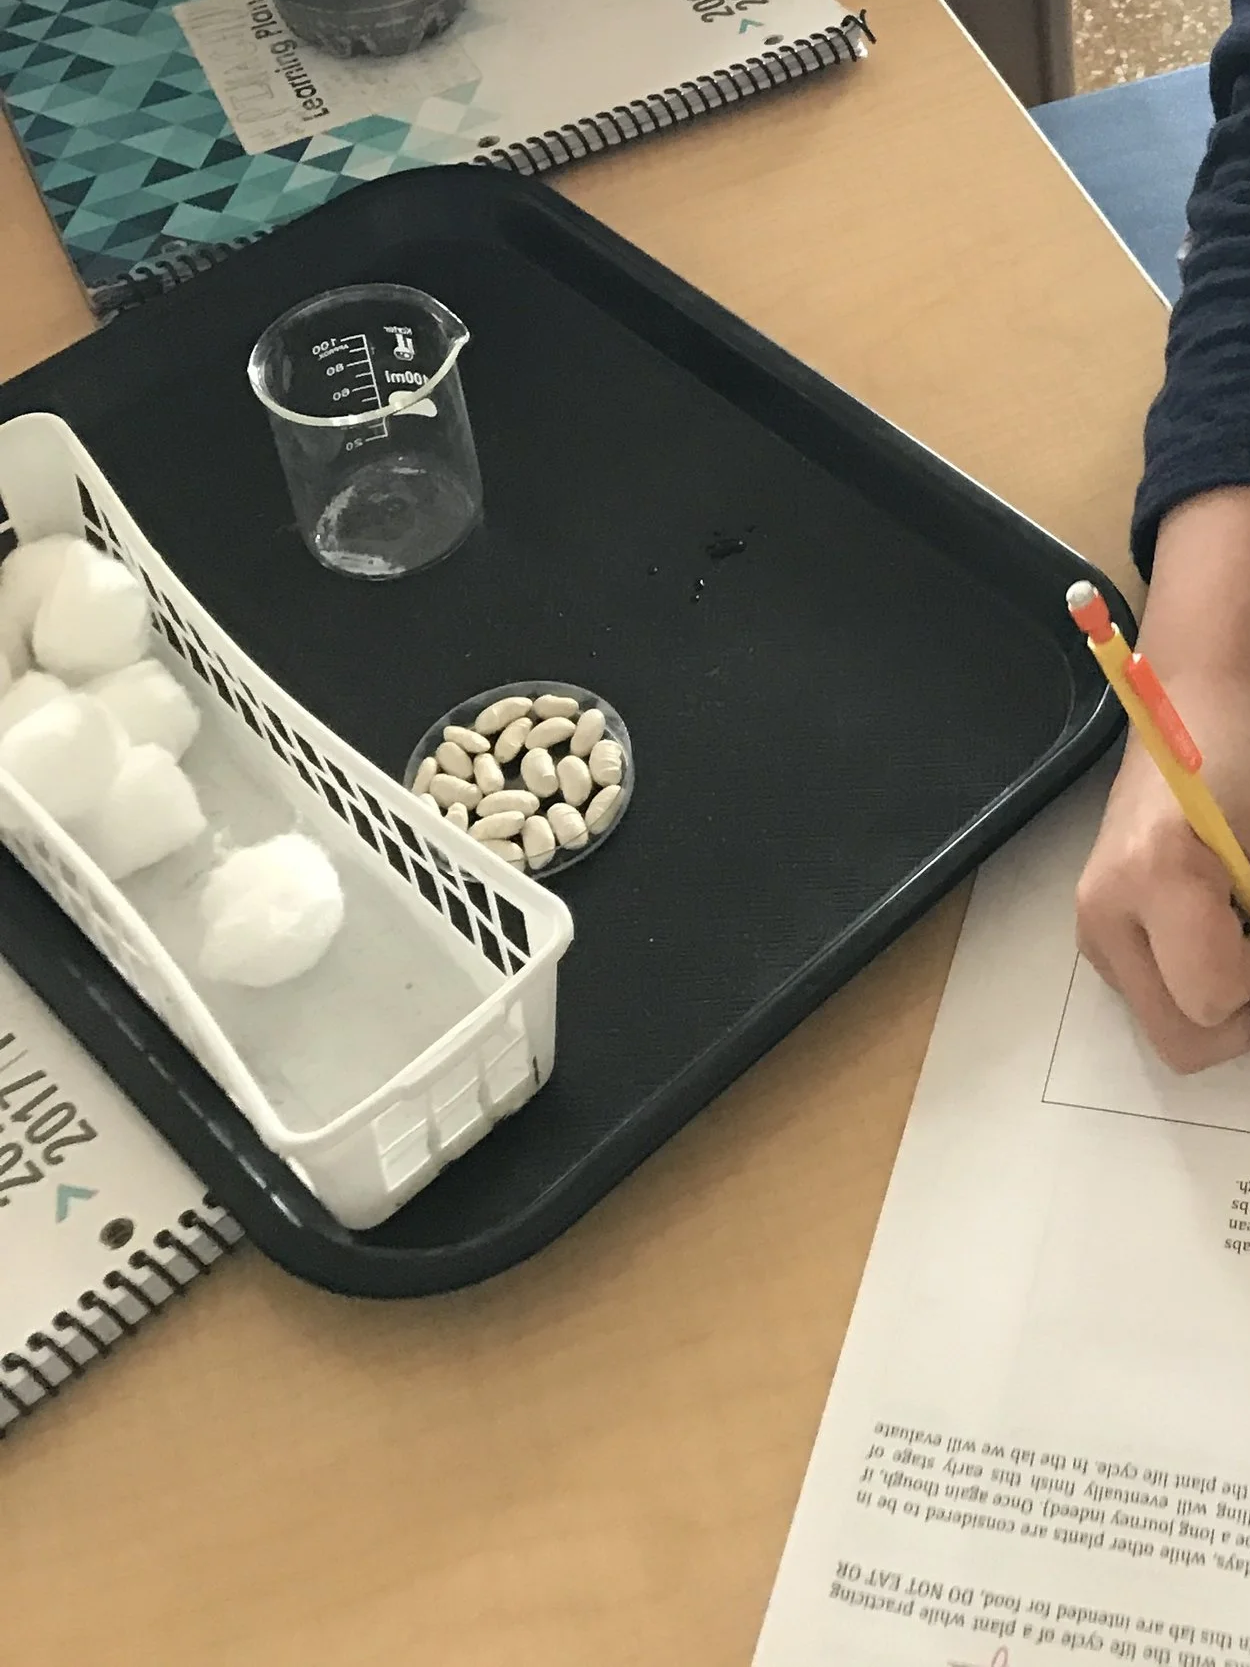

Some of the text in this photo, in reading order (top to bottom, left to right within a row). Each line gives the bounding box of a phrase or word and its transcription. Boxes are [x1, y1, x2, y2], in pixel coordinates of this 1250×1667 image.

[269, 39, 330, 122] Learning
[861, 1466, 875, 1482] if
[856, 1490, 873, 1507] in
[944, 1485, 989, 1504] again
[992, 1494, 1034, 1515] Once
[877, 1496, 898, 1515] be
[903, 1502, 920, 1518] to
[924, 1507, 1016, 1532] considered
[1110, 1510, 1175, 1537] journey
[1020, 1524, 1048, 1538] are
[1054, 1529, 1105, 1550] plants
[1178, 1520, 1216, 1546] long
[1222, 1532, 1232, 1543] a
[1109, 1538, 1155, 1558] other
[1160, 1546, 1206, 1567] while
